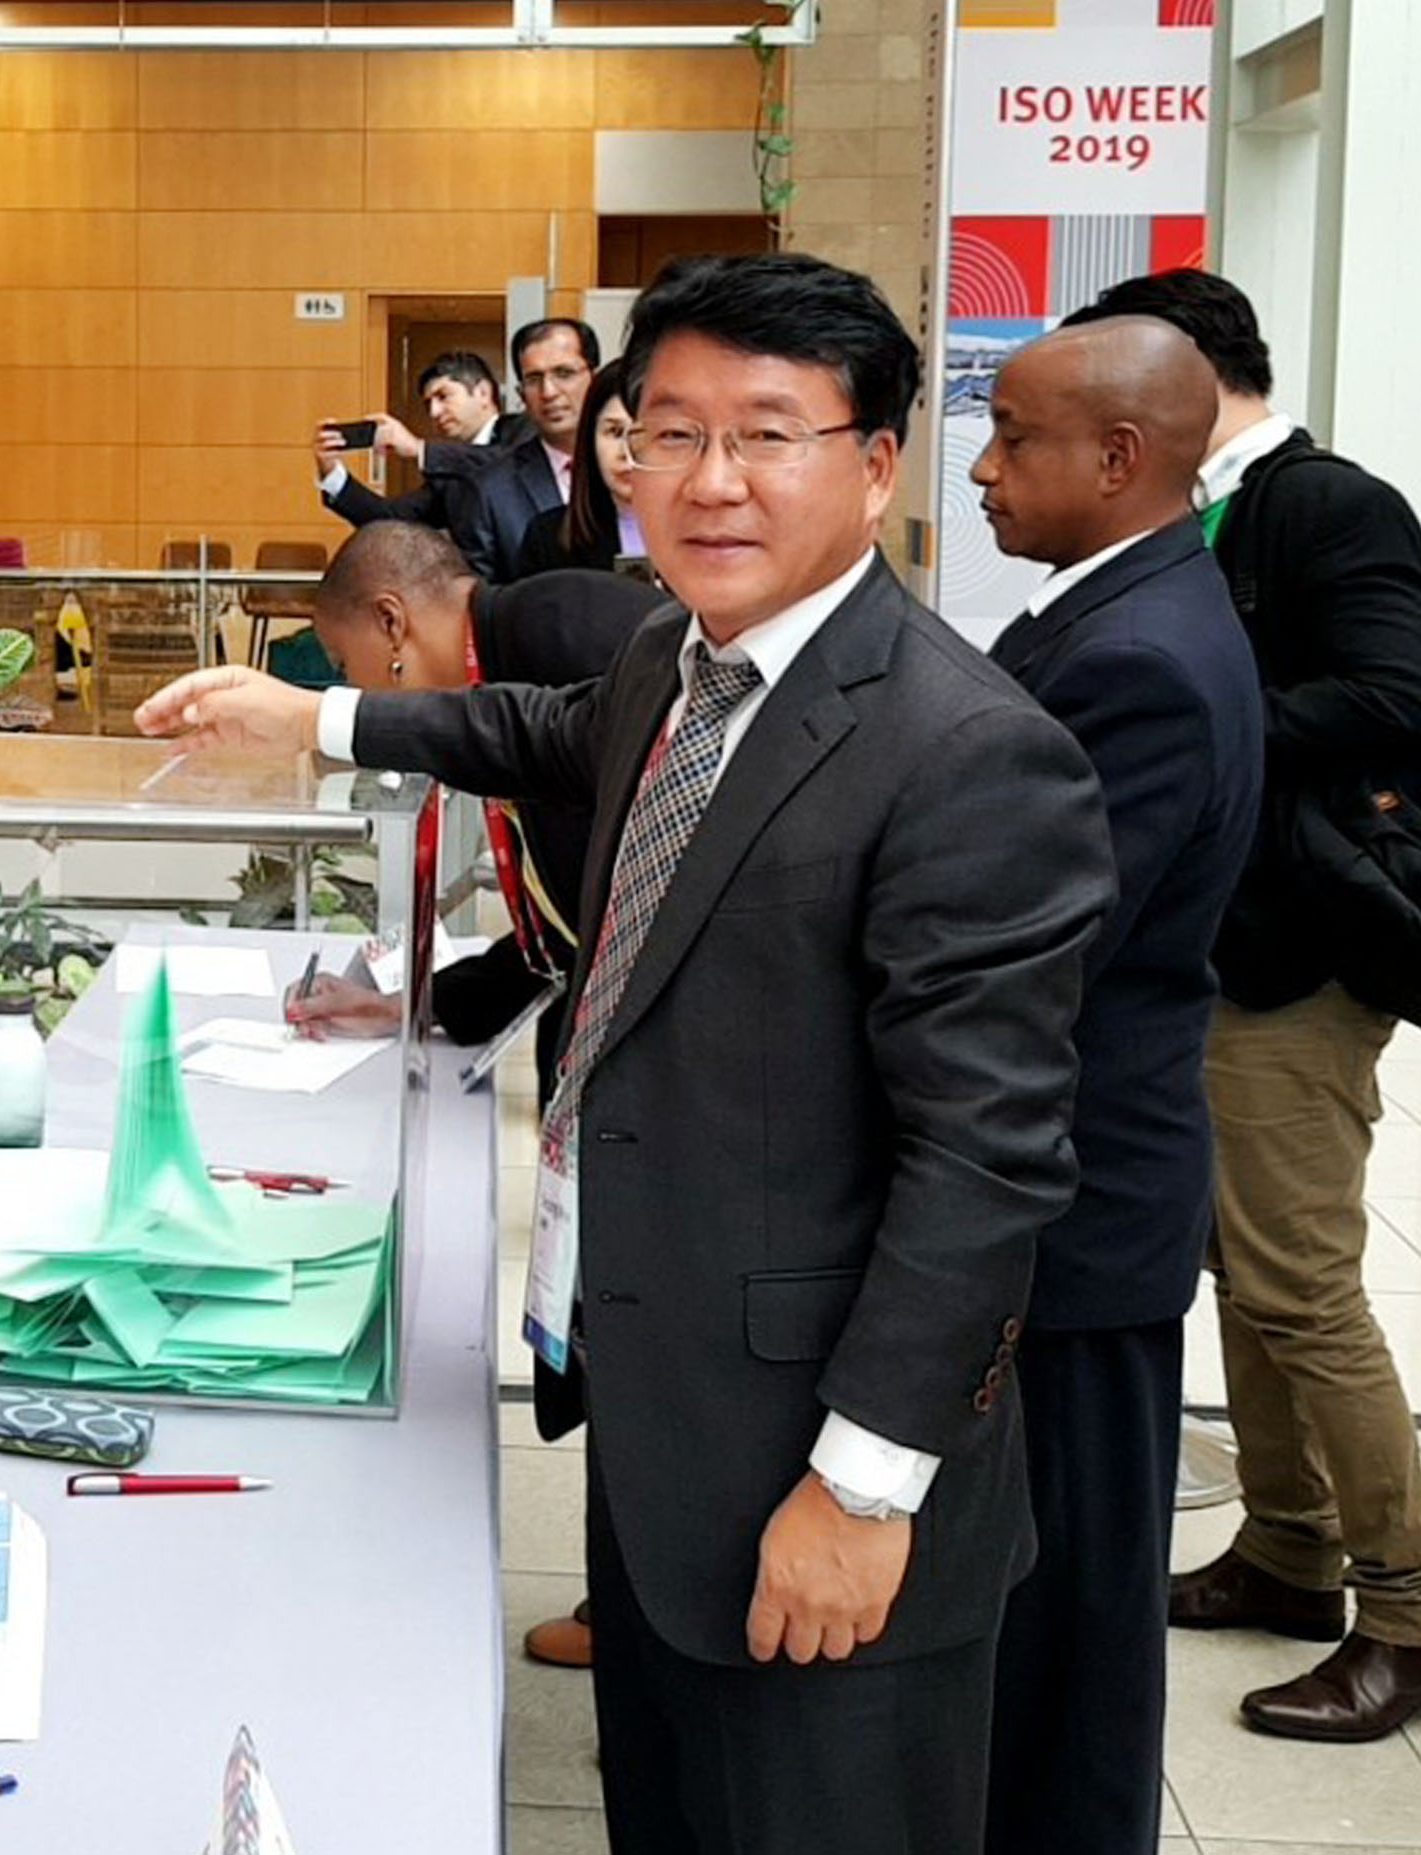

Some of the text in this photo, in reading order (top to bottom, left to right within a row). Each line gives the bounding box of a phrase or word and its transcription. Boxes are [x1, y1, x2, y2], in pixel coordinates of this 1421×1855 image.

[999, 84, 1207, 123] ISO WEEK
[1048, 133, 1151, 171] 2019
